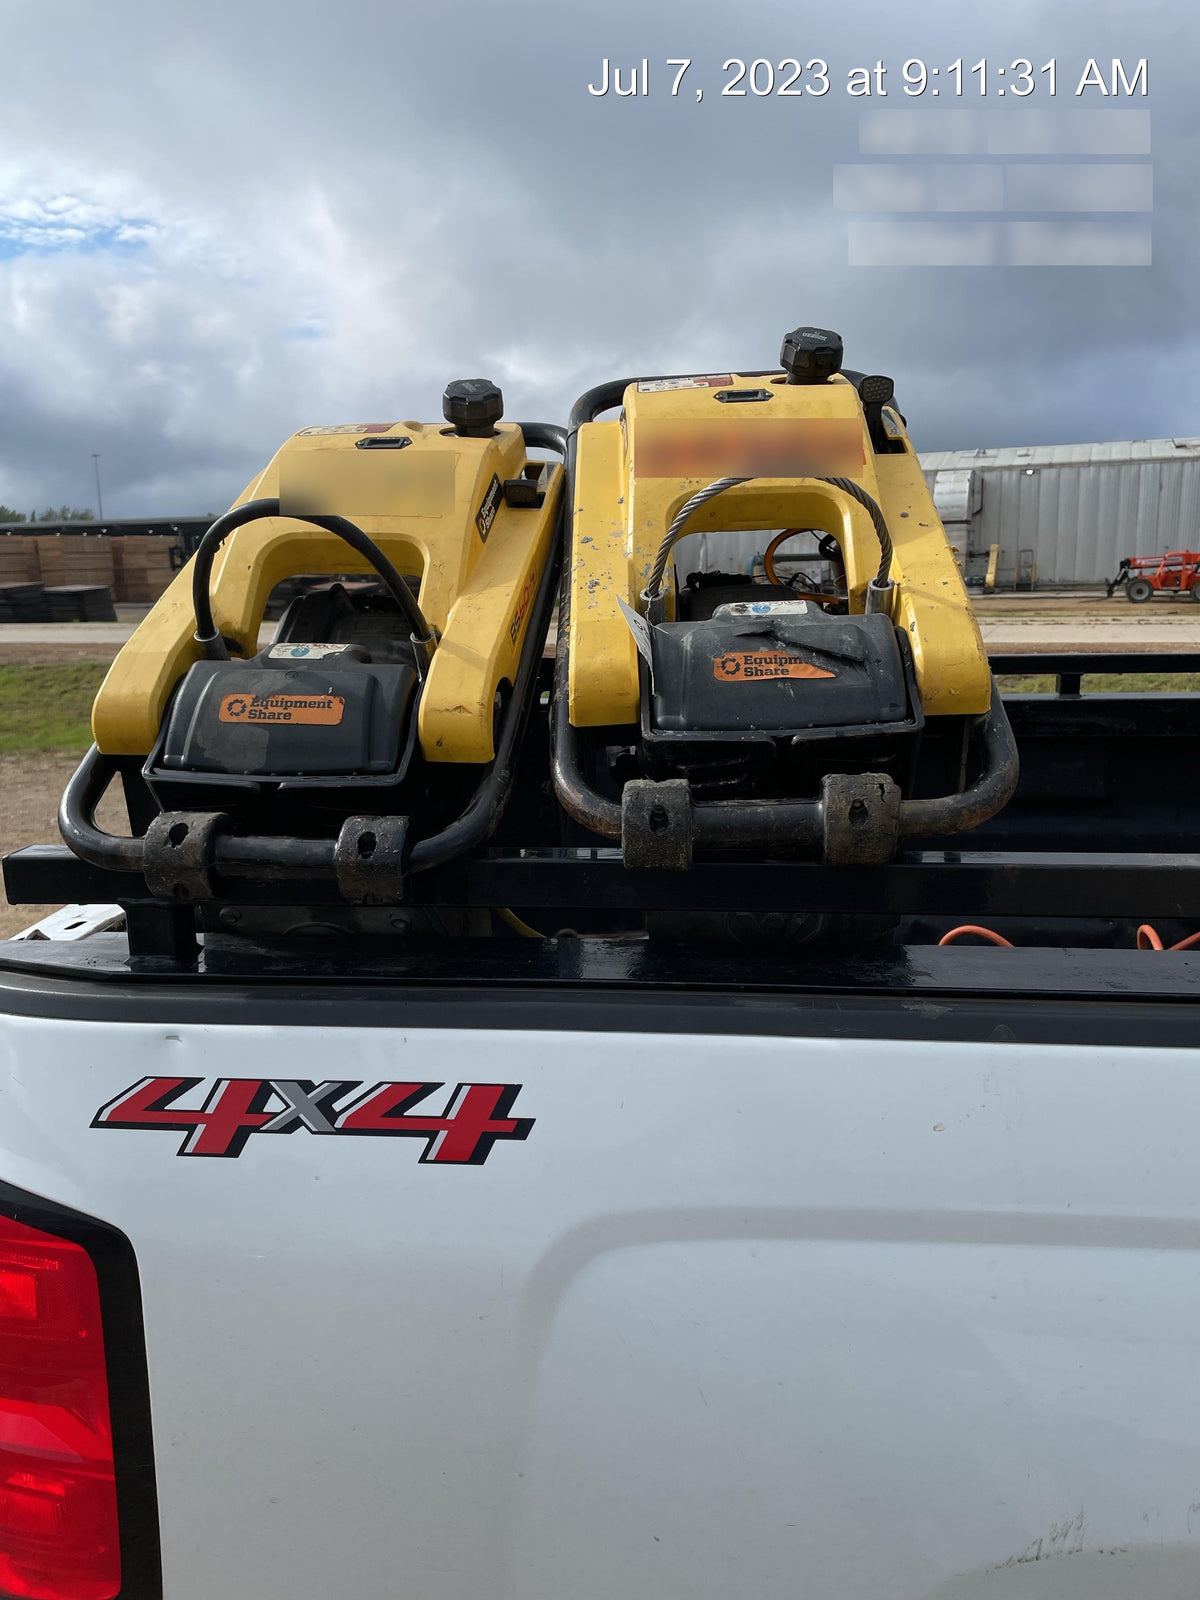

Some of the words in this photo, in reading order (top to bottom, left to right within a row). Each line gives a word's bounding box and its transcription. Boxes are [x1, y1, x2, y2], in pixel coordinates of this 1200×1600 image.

[743, 655, 810, 666] Equipm
[743, 667, 790, 677] Share
[249, 698, 333, 710] Equipment
[247, 709, 292, 720] Share
